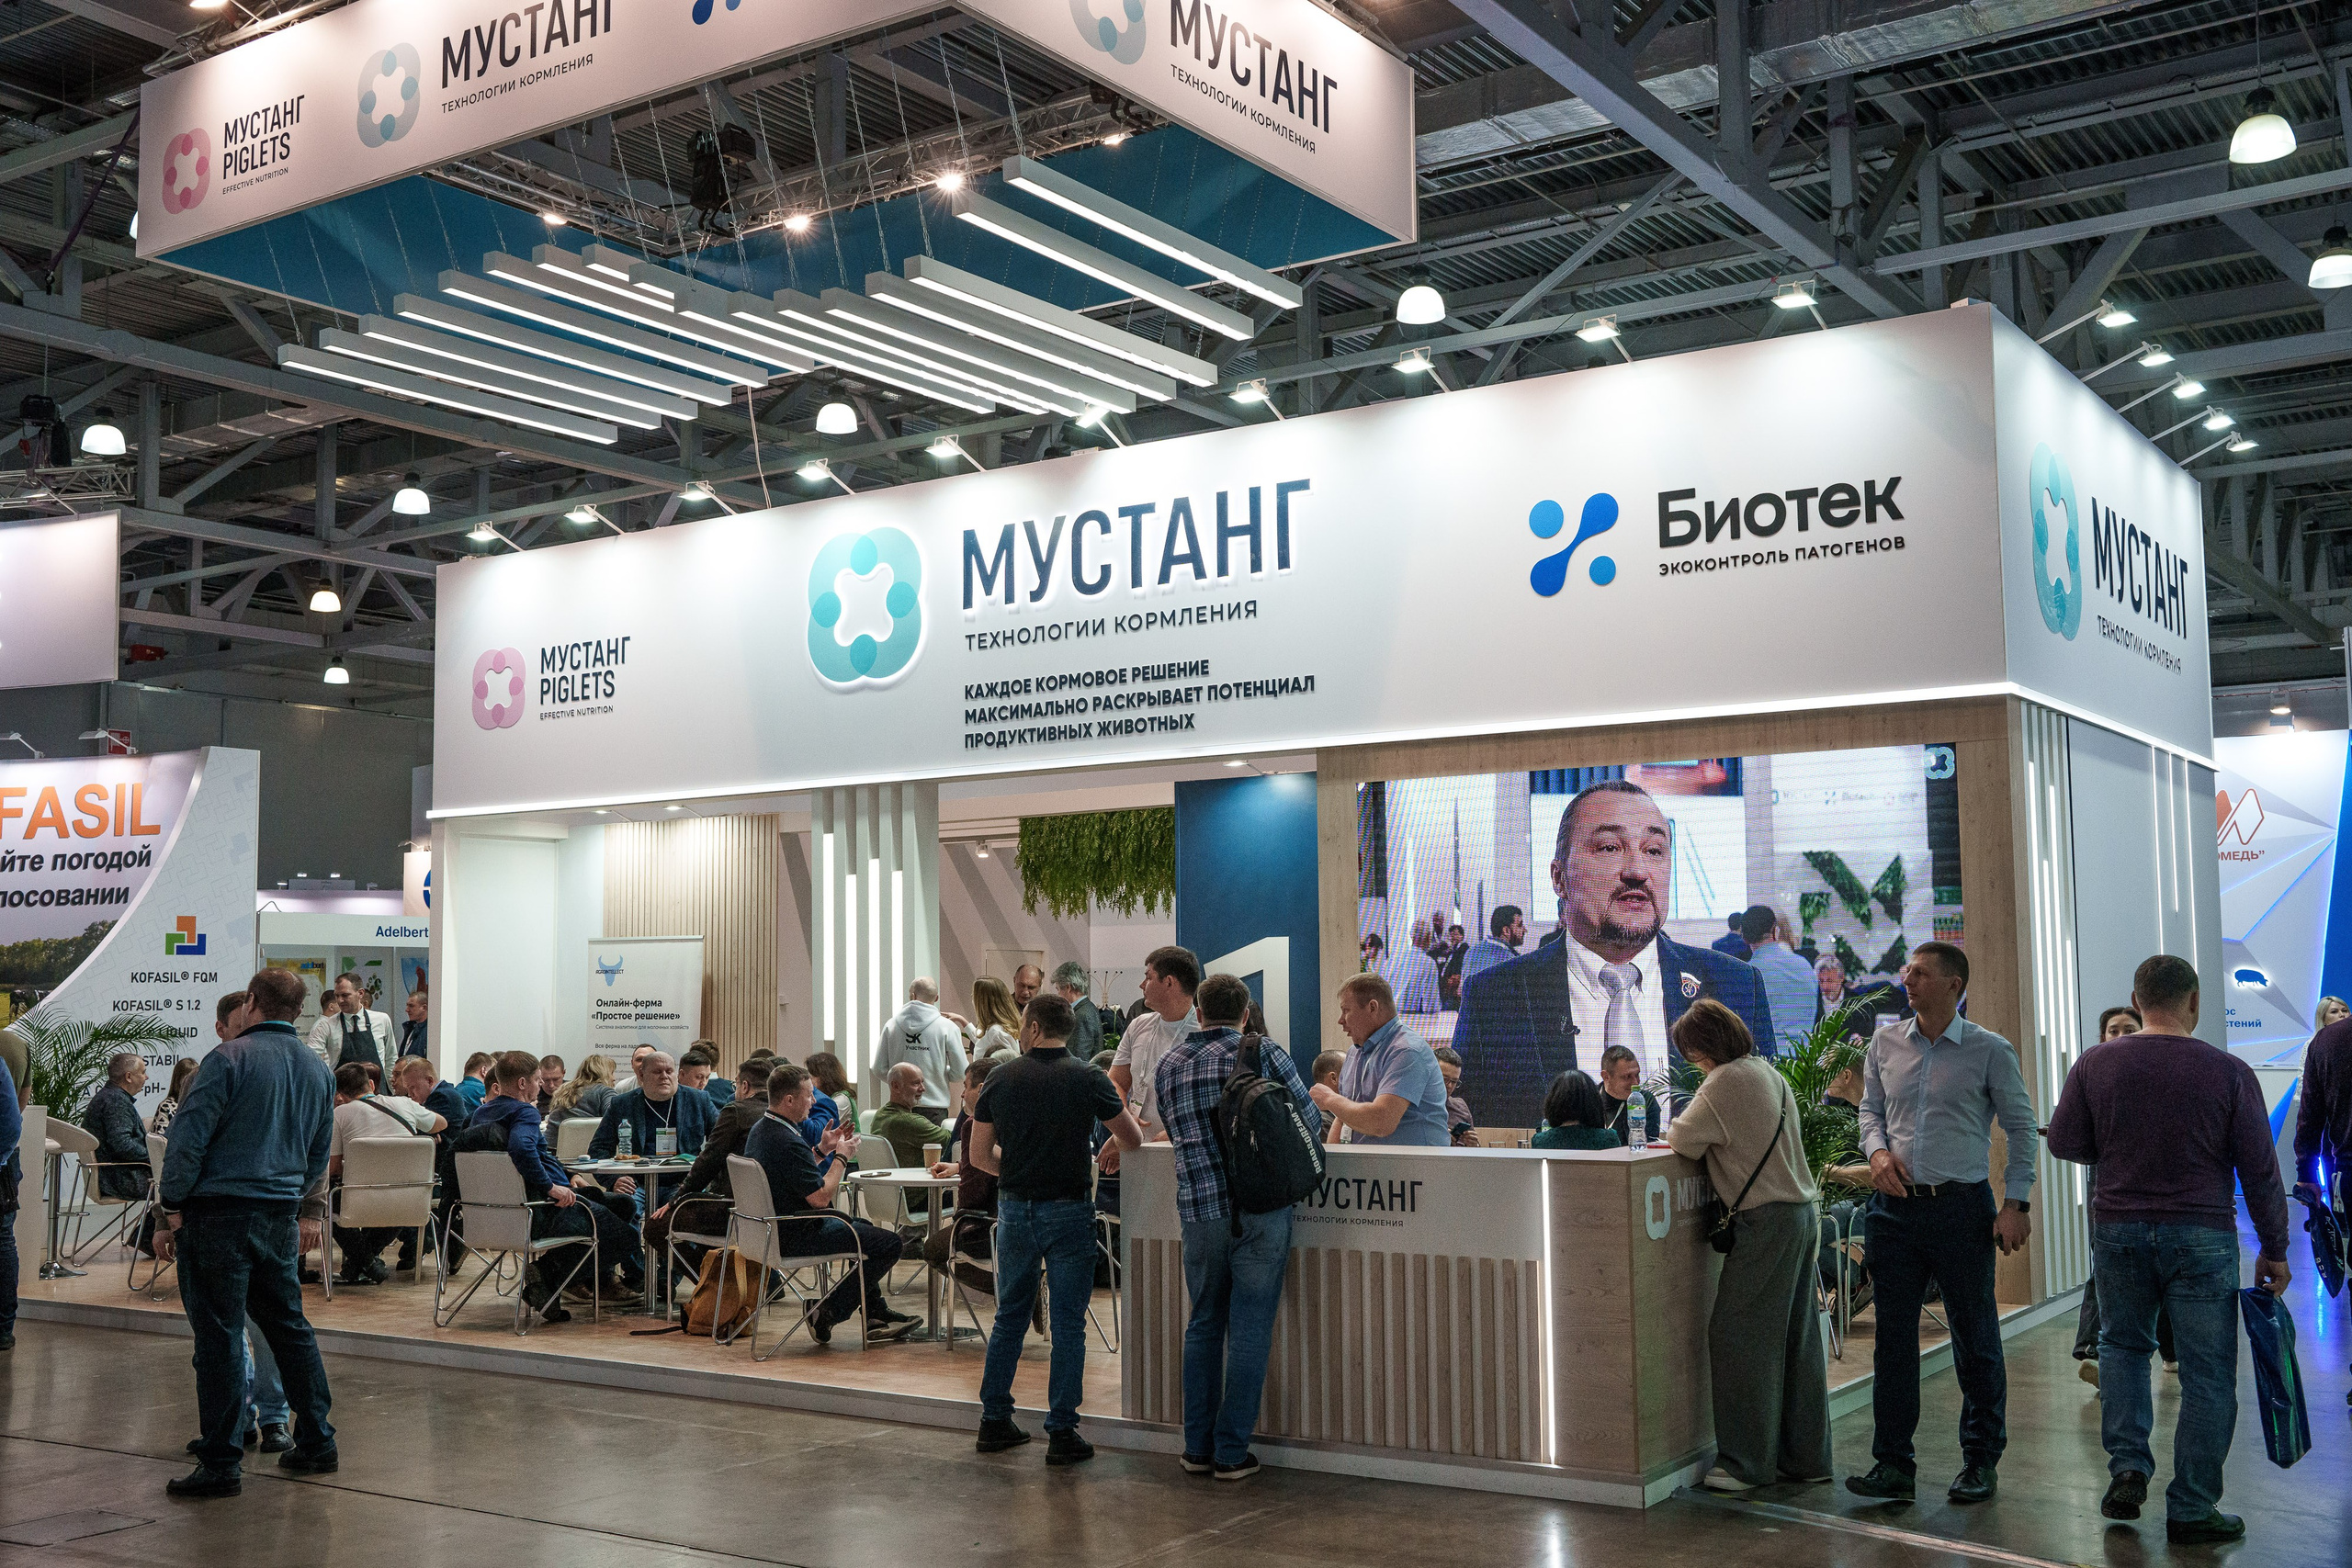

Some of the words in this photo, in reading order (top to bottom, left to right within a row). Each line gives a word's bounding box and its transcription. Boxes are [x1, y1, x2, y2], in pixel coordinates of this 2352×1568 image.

[442, 80, 515, 114] ТЕХНОЛОГИИ
[519, 53, 594, 87] КОРМЛЕНИЯ
[1170, 0, 1338, 134] МУСТАНГ
[224, 95, 305, 149] МУСТАНГ
[1170, 63, 1247, 117] ТЕХНОЛОГИИ
[1250, 108, 1316, 154] КОРМЛЕНИЯ
[223, 131, 290, 179] PIGLETS
[222, 178, 254, 195] EFFECTIVE
[254, 167, 288, 184] NUTRITION
[1658, 476, 1905, 548] Биотек
[962, 478, 1311, 611] МУСТАНГ
[1658, 549, 1790, 576] ЭКОКОНТРОЛЬ
[1794, 536, 1906, 560] ПАТОГЕНОВ
[2091, 496, 2188, 640] МУСТАНГ
[965, 617, 1105, 650] ТЕХНОЛОГИИ
[1114, 600, 1259, 634] КОРМЛЕНИЯ
[540, 636, 631, 674] МУСТАНГ
[2098, 615, 2143, 656] ТЕХНОЛОГИИ
[2143, 639, 2182, 677] КОРМЛЕНИЯ
[540, 670, 616, 705] PIGLETS
[964, 676, 1032, 700] КАЖДОЕ
[1035, 667, 1127, 693] КОРМОВОЕ
[1131, 659, 1210, 683] РЕШЕНИЕ
[539, 709, 575, 720] EFFECTIVE
[577, 705, 614, 716] NUTRITION
[965, 697, 1089, 725] МАКСИМАЛЬНО
[1092, 685, 1203, 712] РАСКРЫВАЕТ
[1207, 674, 1316, 701] ПОТЕНЦИАЛ
[964, 722, 1092, 749] ПРОДУКТИВНЫХ
[1097, 713, 1194, 738] ЖИВОТНЫХ
[51, 843, 152, 873] погодой
[2218, 850, 2265, 862] МЕДЬ”
[375, 925, 429, 938] Adelbert
[193, 972, 218, 983] FQM
[175, 999, 184, 1010] S
[187, 999, 201, 1010] 1.2
[591, 1011, 632, 1021] «Простое
[634, 1012, 681, 1021] решение»
[595, 998, 662, 1009] Онлайн-ферма
[1292, 1214, 1348, 1224] ТЕХНОЛОГИИ
[1350, 1218, 1404, 1227] КОРМЛЕНИЯ
